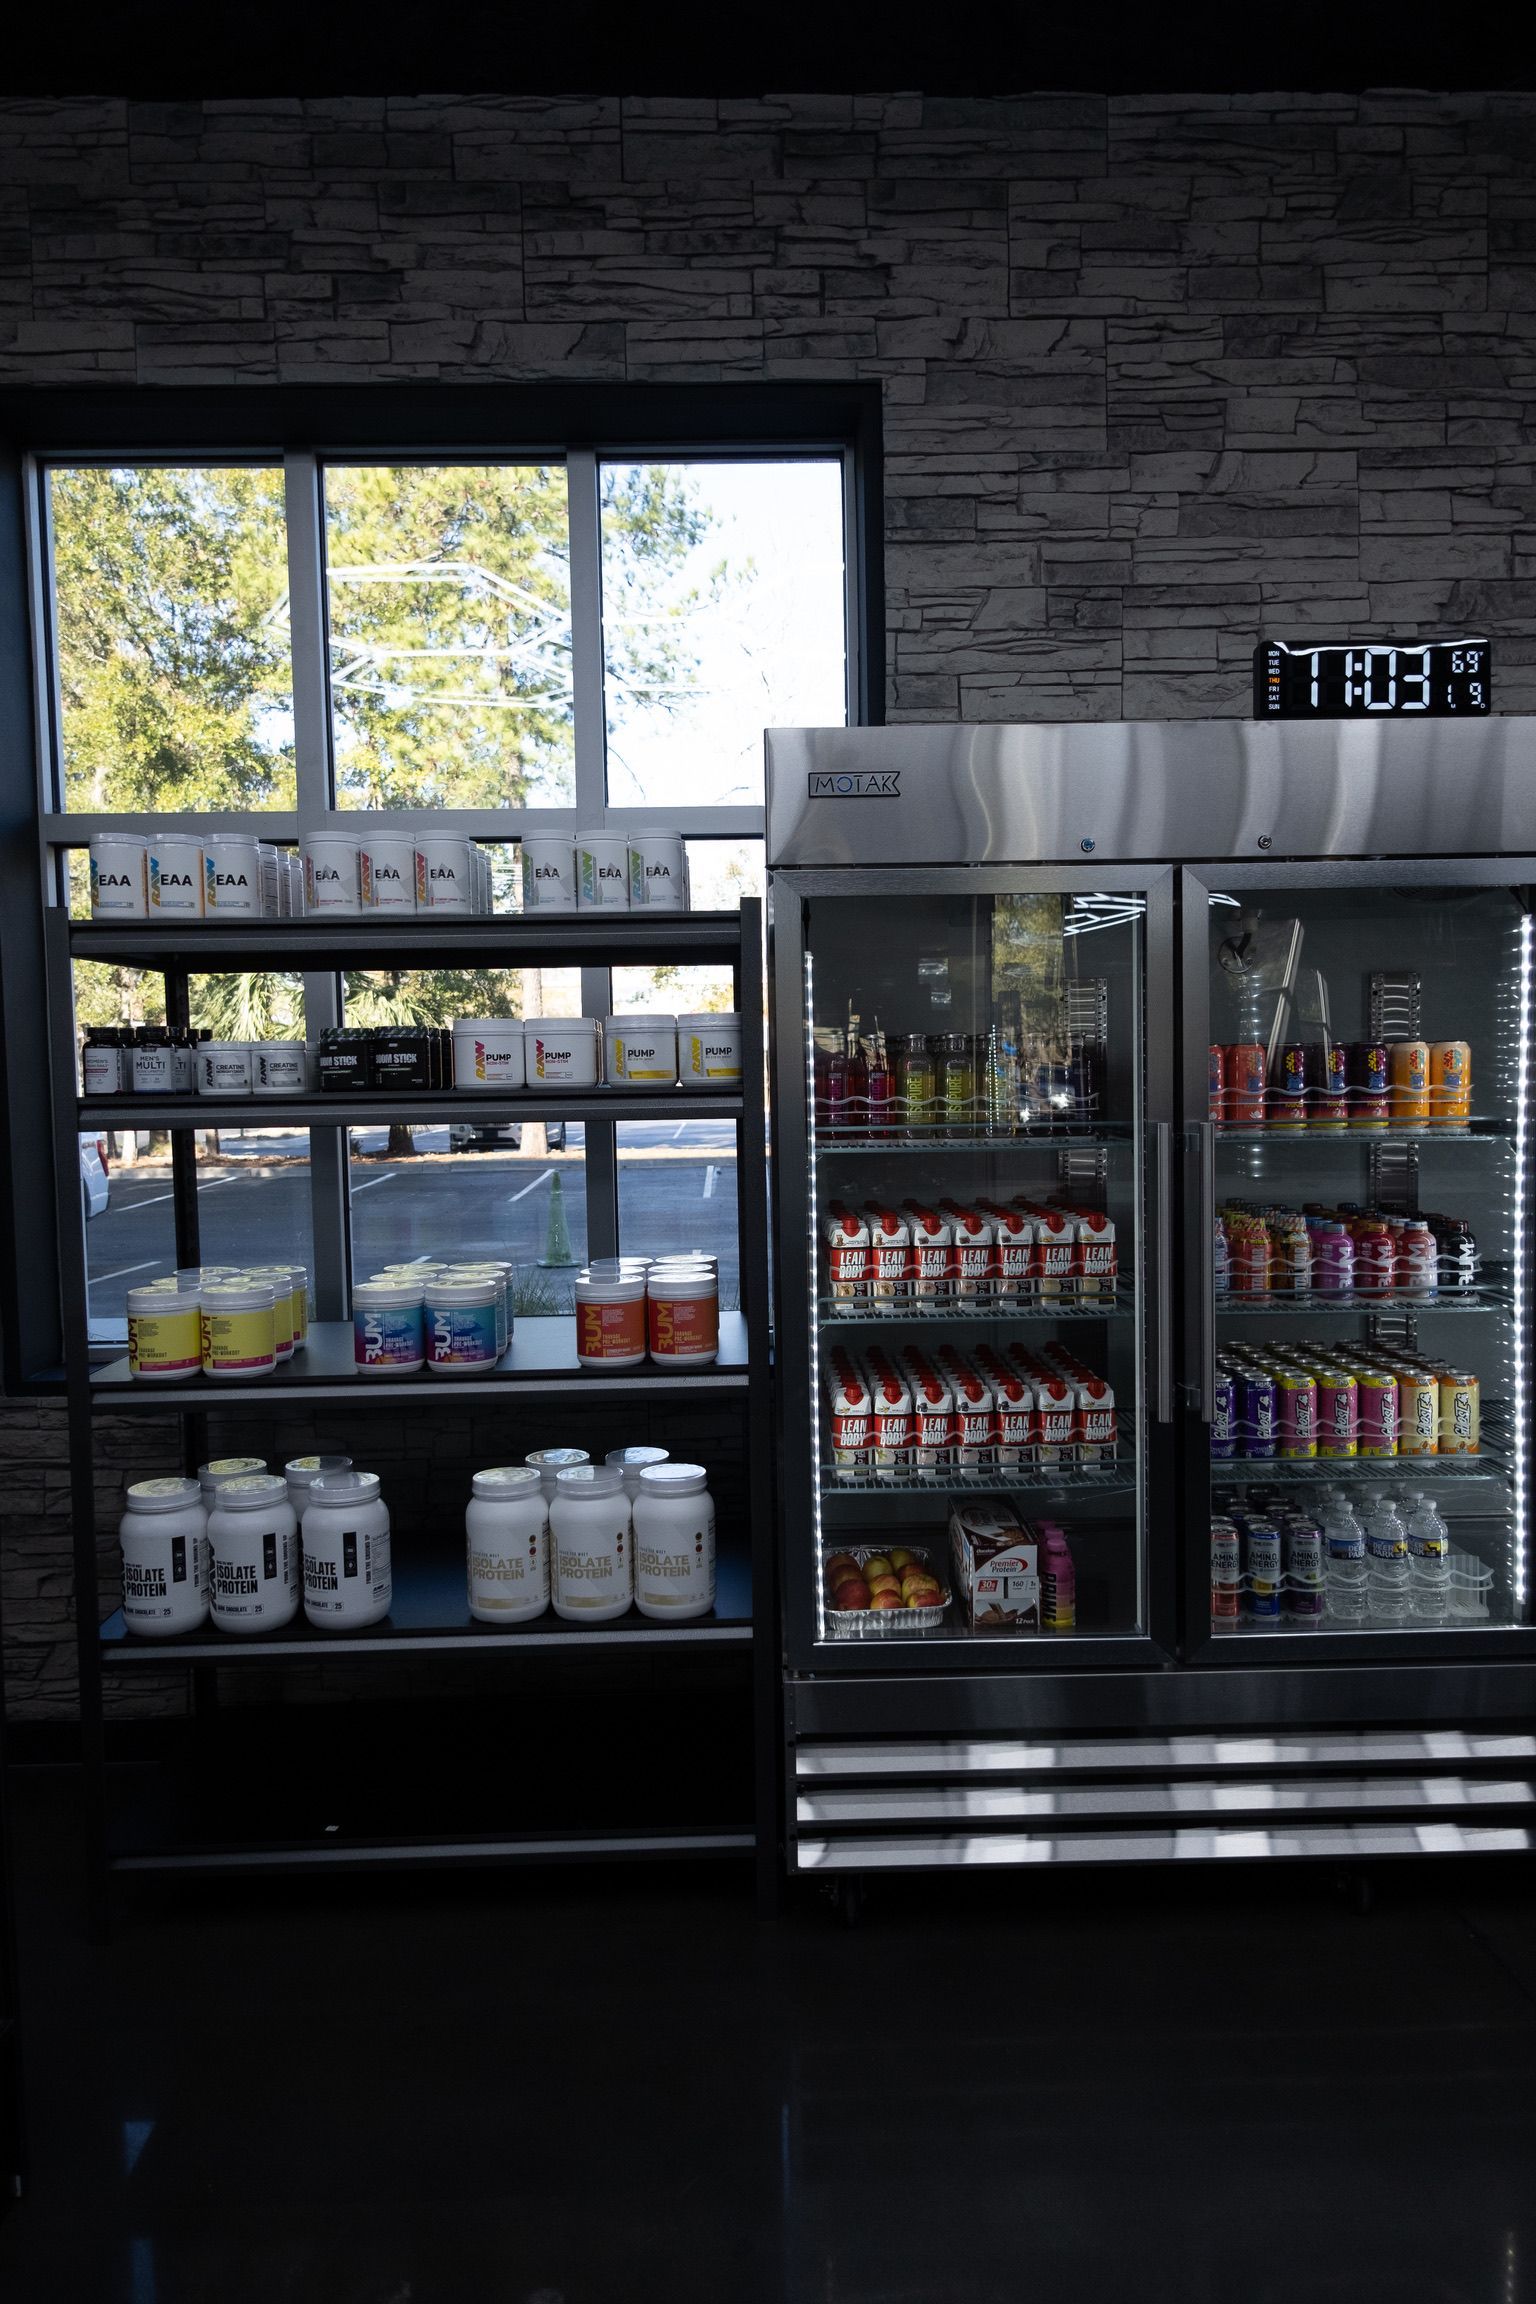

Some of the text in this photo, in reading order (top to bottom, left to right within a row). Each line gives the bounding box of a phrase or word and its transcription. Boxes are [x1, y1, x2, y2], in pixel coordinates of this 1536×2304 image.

[1452, 651, 1478, 673] 69
[1311, 648, 1430, 710] 11:03
[1470, 683, 1482, 704] 9
[815, 775, 892, 793] MOTAK
[316, 870, 340, 880] EAA
[362, 852, 370, 902] RAW
[376, 870, 400, 879] EAA
[416, 852, 426, 902] RAW
[430, 869, 455, 878] EAA
[536, 868, 560, 878] EAA
[583, 850, 592, 900] RAW
[600, 868, 622, 878] EAA
[632, 850, 640, 900] RAW
[646, 867, 670, 876] EAA
[100, 874, 131, 886] EAA
[160, 874, 193, 886] EAA
[216, 874, 248, 886] EAA
[486, 1053, 512, 1062] PUMP
[545, 1052, 572, 1060] PUMP
[627, 1050, 655, 1059] PUMP
[705, 1047, 732, 1056] PUMP
[333, 1056, 358, 1066] STICK
[393, 1054, 418, 1064] STICK
[840, 1251, 866, 1265] LEAN
[880, 1250, 906, 1264] LEAN
[922, 1250, 947, 1264] LEAN
[962, 1250, 988, 1263] LEAN
[1004, 1249, 1031, 1262] LEAN
[1046, 1248, 1072, 1261] LEAN
[1086, 1247, 1112, 1260] LEAN
[840, 1265, 864, 1278] BODY
[879, 1264, 904, 1278] BODY
[921, 1264, 946, 1277] BODY
[962, 1263, 987, 1276] BODY
[1003, 1262, 1029, 1275] BODY
[1045, 1261, 1070, 1274] BODY
[1085, 1261, 1110, 1274] BODY
[1458, 1244, 1475, 1287] BUM
[584, 1305, 602, 1355] BUM
[656, 1302, 674, 1352] BUM
[923, 1418, 948, 1432] LEAN
[965, 1418, 989, 1430] LEAN
[1006, 1416, 1030, 1429] LEAN
[1047, 1415, 1072, 1428] LEAN
[1087, 1414, 1112, 1426] LEAN
[1296, 1402, 1310, 1438] GHOST
[1334, 1402, 1349, 1437] GHOST
[1381, 1400, 1395, 1437] GHOST
[1417, 1400, 1432, 1438] GHOST
[1454, 1399, 1470, 1438] GHOST
[842, 1420, 867, 1432] LEAN
[882, 1419, 907, 1432] LEAN
[841, 1432, 865, 1446] BODY
[880, 1432, 906, 1446] BODY
[922, 1432, 946, 1445] BODY
[964, 1430, 988, 1444] BODY
[1004, 1429, 1029, 1442] BODY
[1045, 1428, 1071, 1441] BODY
[1086, 1426, 1110, 1440] BODY
[1374, 1542, 1392, 1552] DEER
[640, 1552, 689, 1566] ISOLATE
[1249, 1552, 1277, 1560] AMINO
[1374, 1550, 1394, 1558] PARK
[473, 1556, 523, 1569] ISOLATE
[560, 1556, 612, 1568] ISOLATE
[990, 1560, 1019, 1568] Premier
[1249, 1560, 1278, 1568] ENERGY
[126, 1568, 164, 1582] ISOLATE
[217, 1565, 256, 1579] ISOLATE
[473, 1567, 524, 1580] PROTEIN
[560, 1566, 612, 1579] PROTEIN
[640, 1564, 690, 1577] PROTEIN
[126, 1582, 166, 1596] PROTEIN
[218, 1580, 258, 1594] PROTEIN
[335, 1602, 342, 1610] 25
